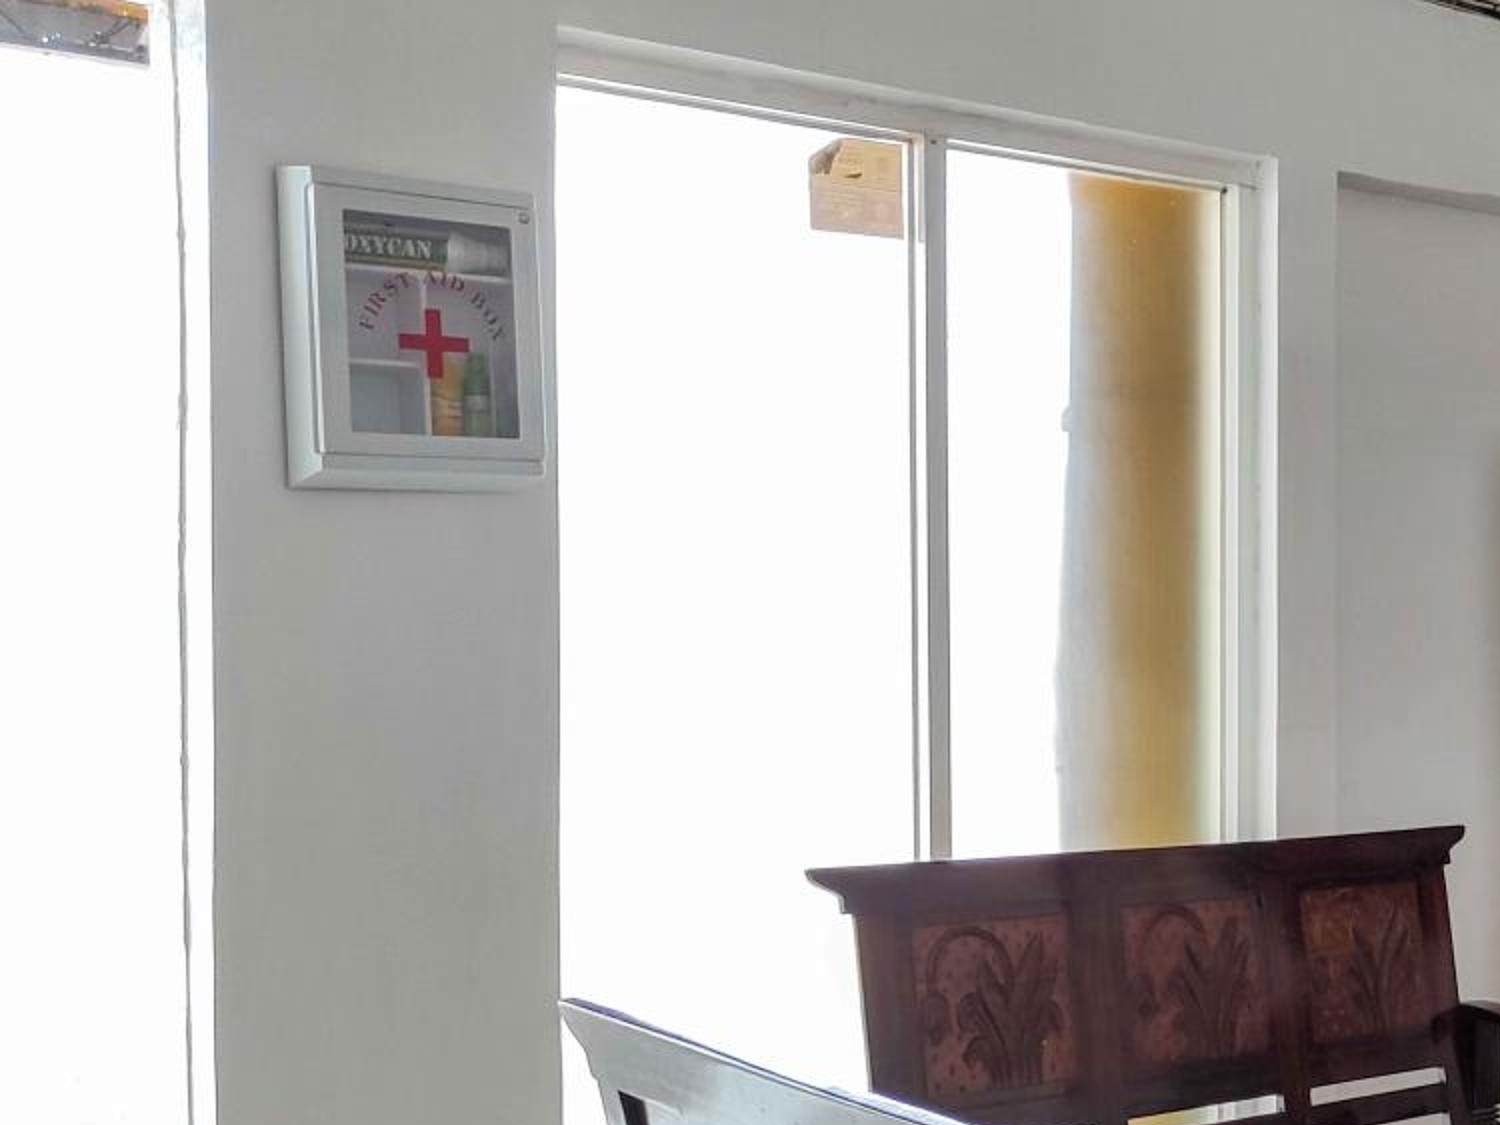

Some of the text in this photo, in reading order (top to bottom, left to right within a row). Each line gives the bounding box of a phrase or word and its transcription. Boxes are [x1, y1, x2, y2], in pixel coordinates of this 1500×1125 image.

[358, 270, 504, 341] FIRST AID BOX
